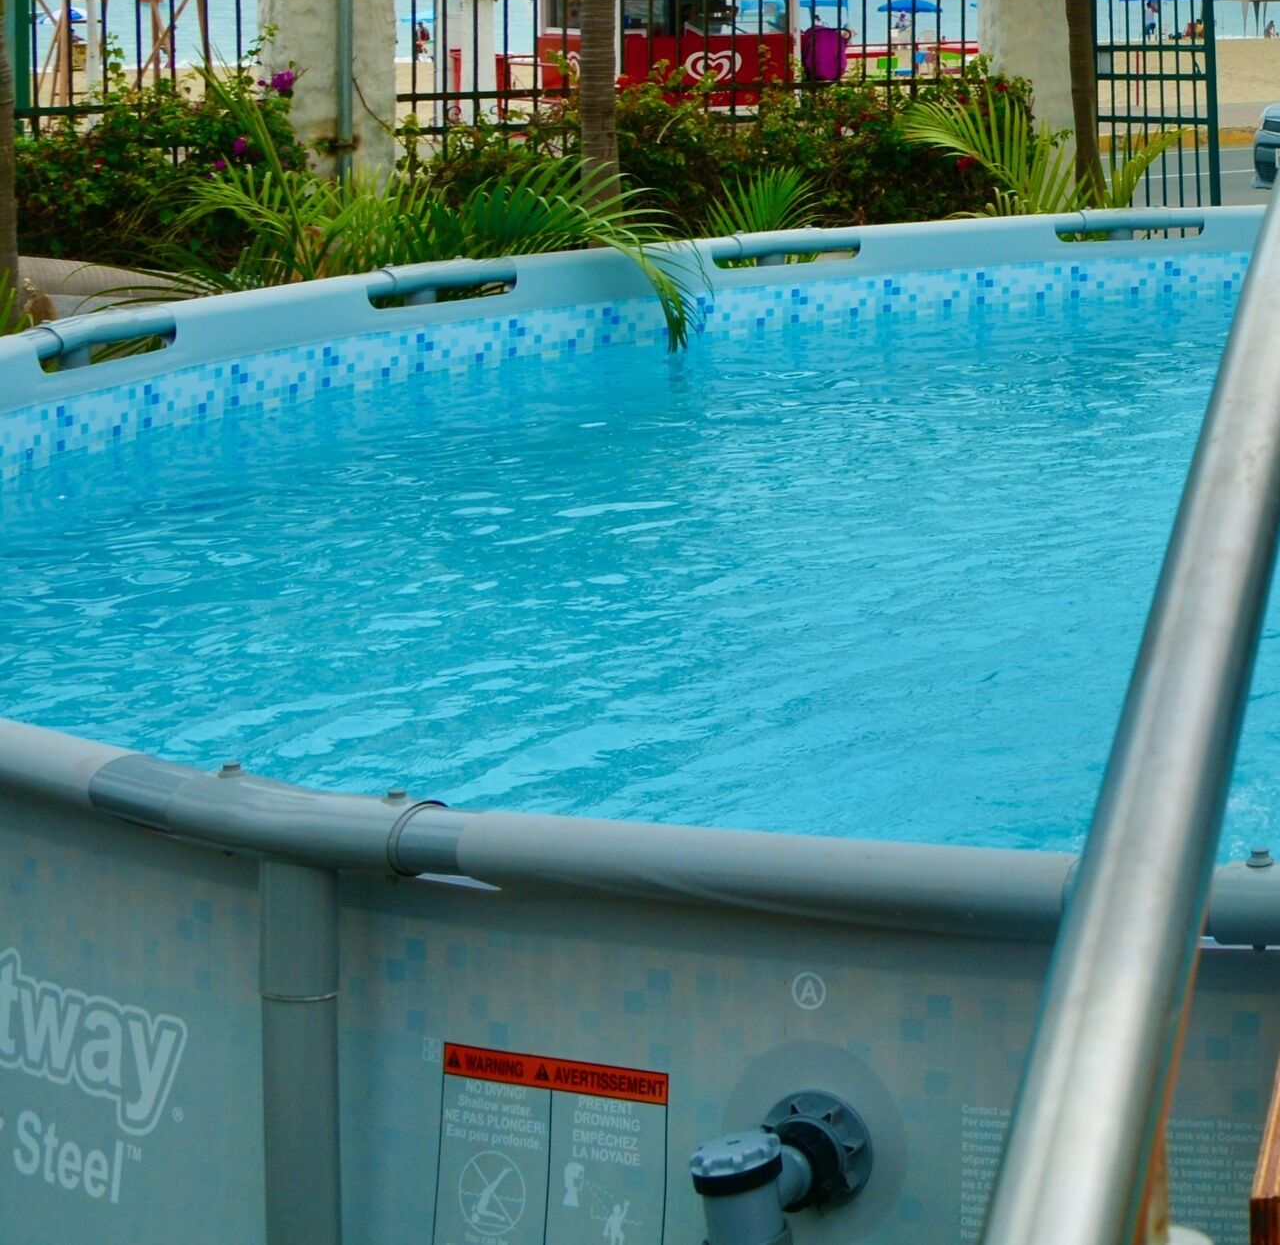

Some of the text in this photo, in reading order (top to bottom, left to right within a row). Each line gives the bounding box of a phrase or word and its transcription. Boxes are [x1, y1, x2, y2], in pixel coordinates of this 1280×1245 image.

[465, 1053, 665, 1097] WARNING AVERTISSEMENT
[465, 1079, 526, 1100] NO DIVING!
[458, 1094, 533, 1117] Shallow water.
[578, 1095, 634, 1115] PREVENT
[445, 1108, 545, 1135] NE PAS PLONGER!
[574, 1111, 641, 1132] DROWNING
[446, 1124, 544, 1150] Eau peu profonde.
[13, 1110, 125, 1205] Steel
[573, 1144, 641, 1167] LA NOYADE
